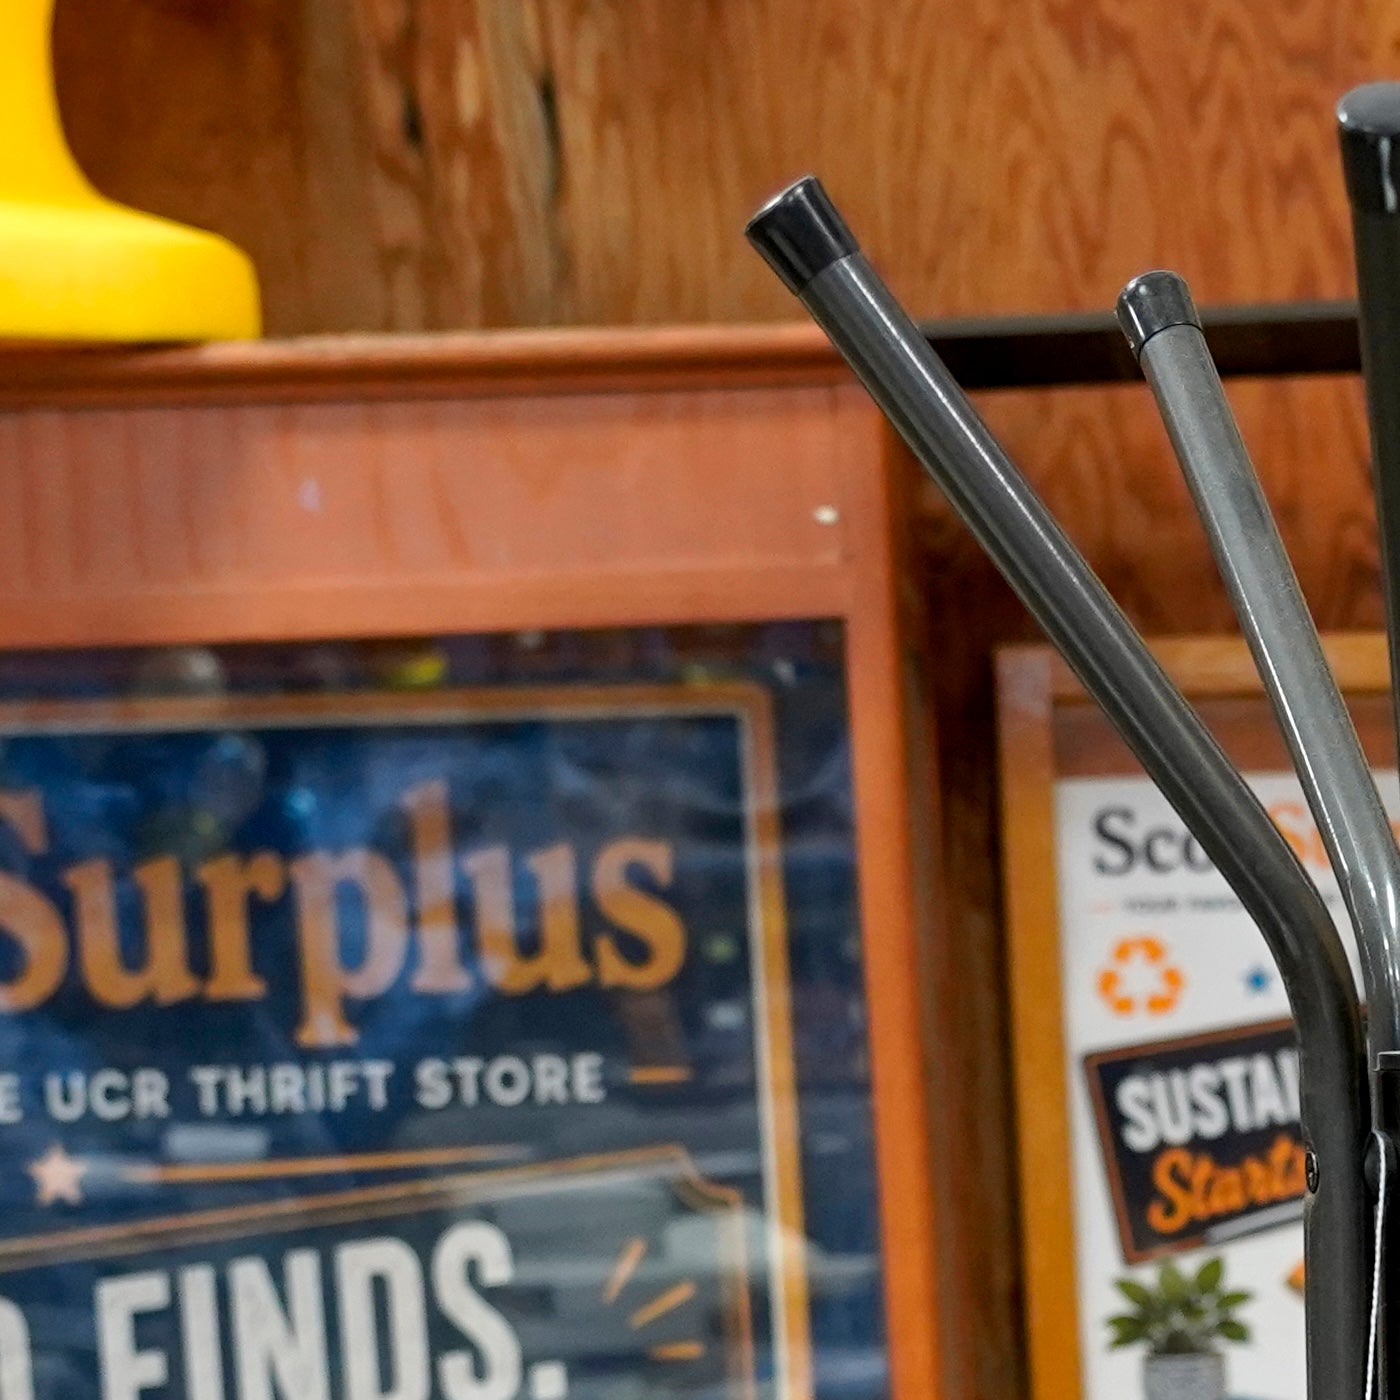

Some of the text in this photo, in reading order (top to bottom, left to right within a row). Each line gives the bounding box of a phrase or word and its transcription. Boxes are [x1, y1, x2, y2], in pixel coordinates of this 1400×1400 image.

[1093, 807, 1214, 876] Sco
[45, 1066, 171, 1122] UCR
[192, 1060, 393, 1114] THRIFT
[415, 1052, 607, 1110] STORE
[1116, 1048, 1300, 1153] SUSTAI
